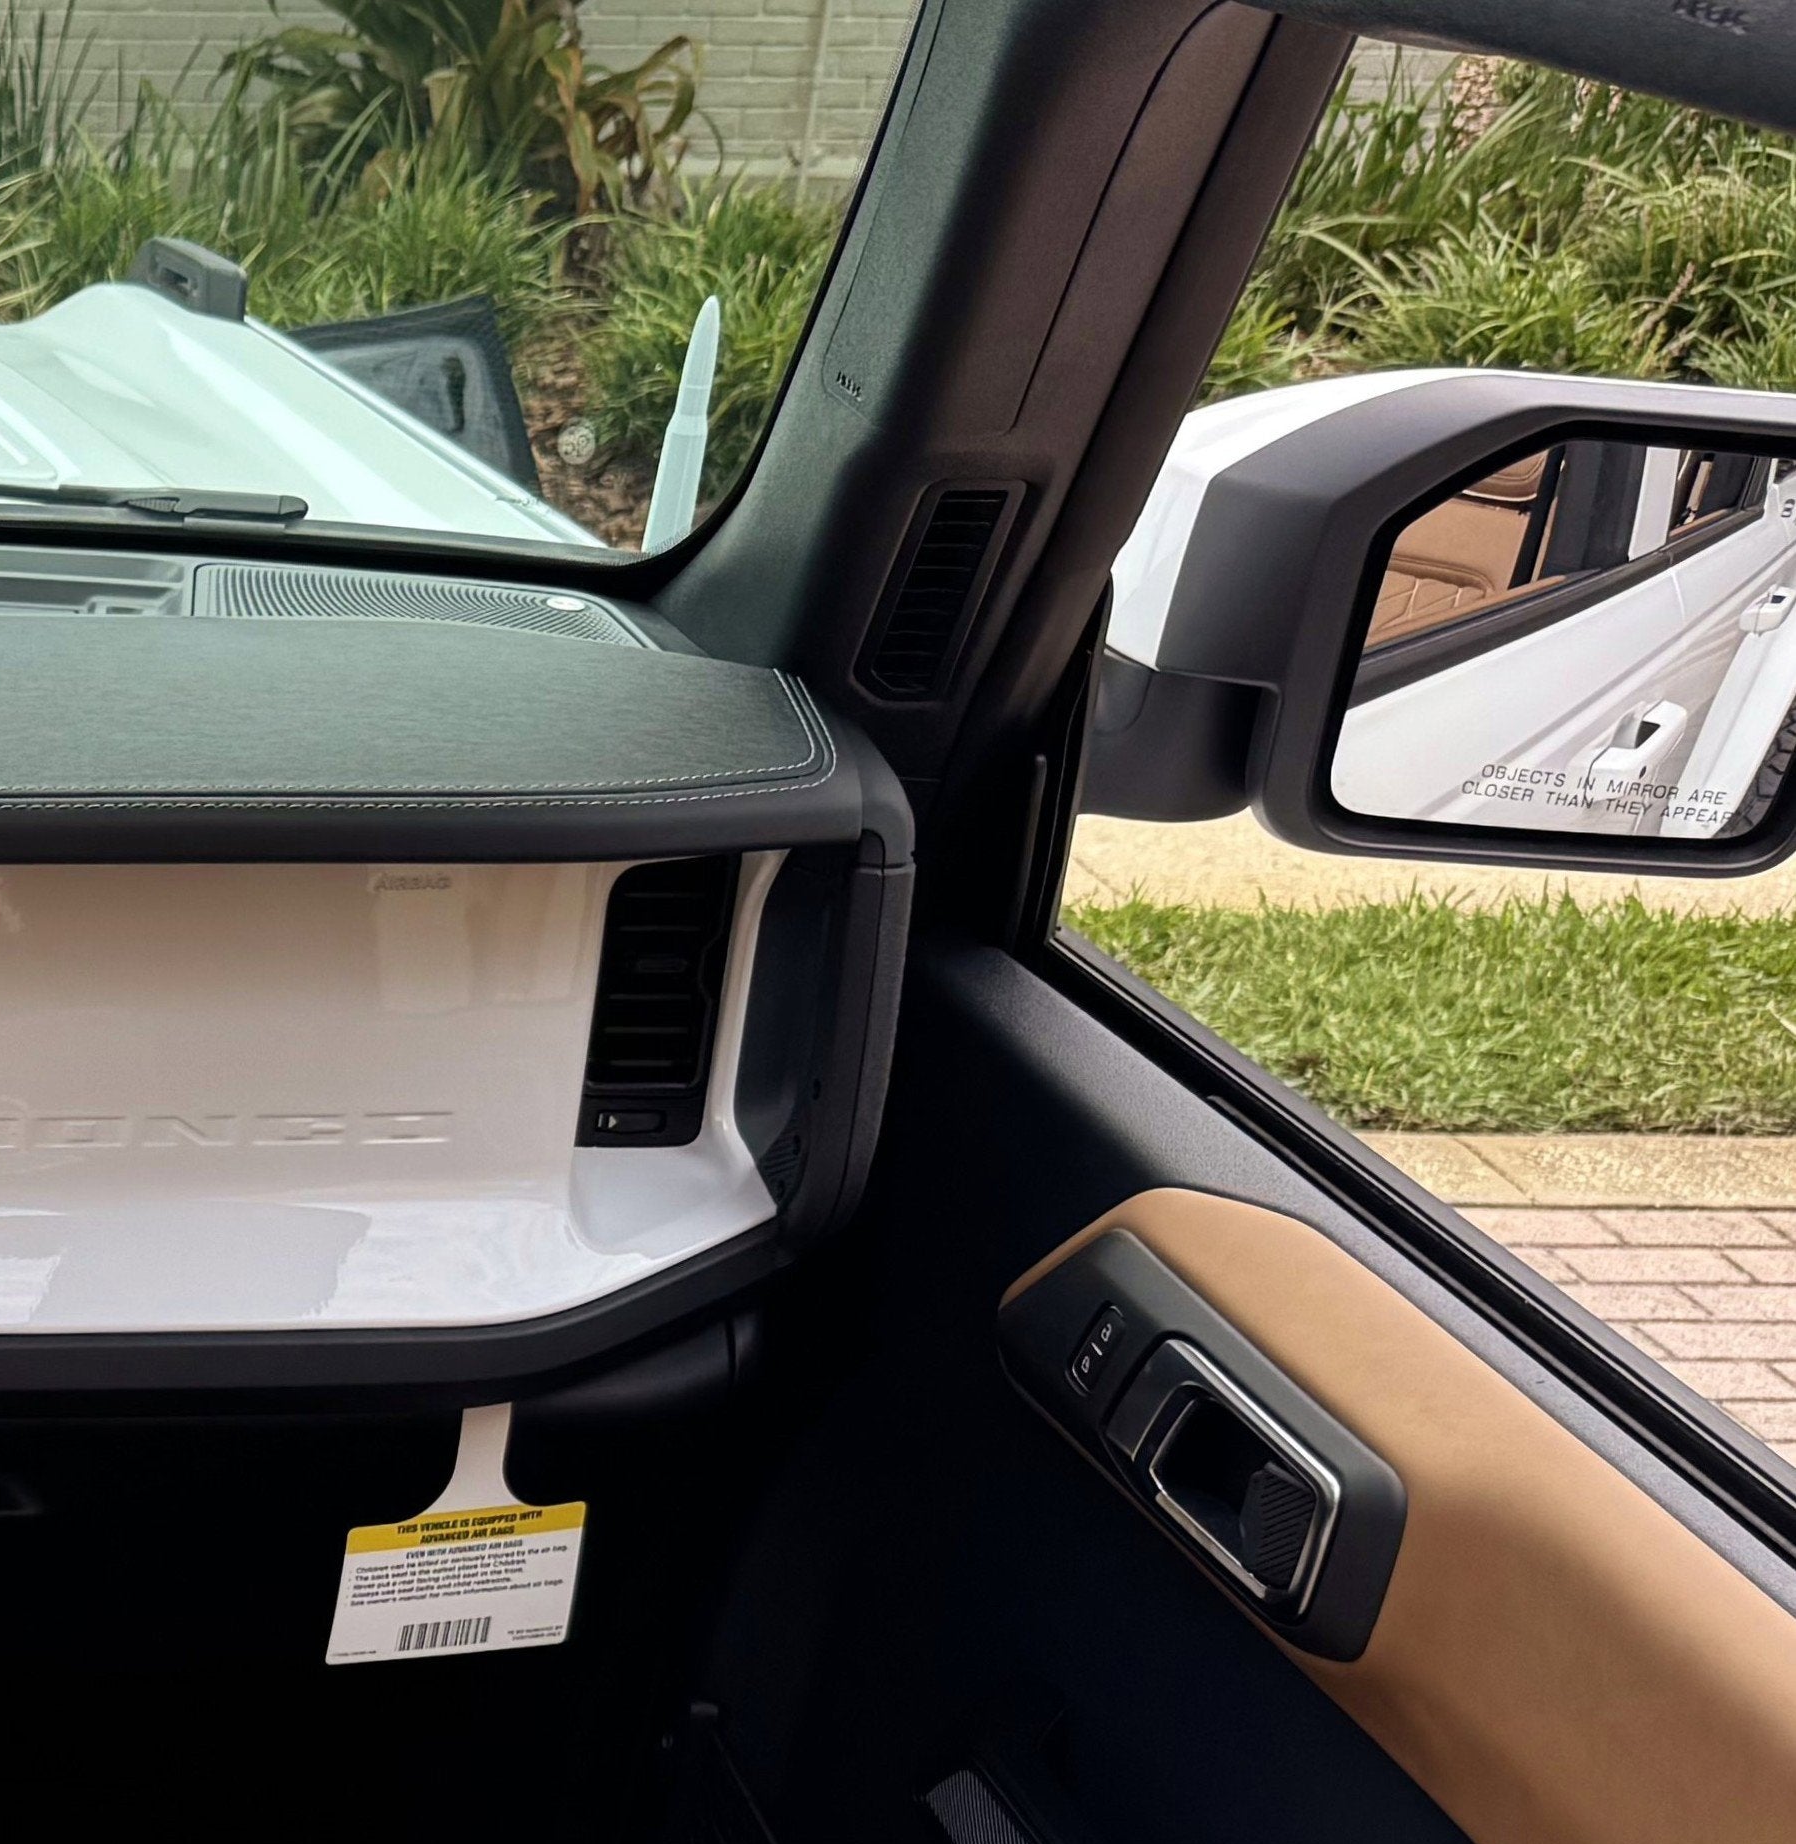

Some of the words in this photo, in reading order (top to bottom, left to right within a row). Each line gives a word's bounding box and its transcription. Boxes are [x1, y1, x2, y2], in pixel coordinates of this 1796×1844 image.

[1461, 779, 1536, 803] CLOSER
[1545, 791, 1594, 811] THAN
[1605, 797, 1654, 817] THEY
[1481, 763, 1567, 788] OBJECTS
[1577, 775, 1596, 791] IN
[1606, 778, 1680, 802] MIRROR
[1688, 788, 1729, 807] ARE
[420, 1520, 459, 1531] VEHICLE
[471, 1513, 518, 1527] EQUIPPED
[420, 1531, 470, 1544] ADVANCED
